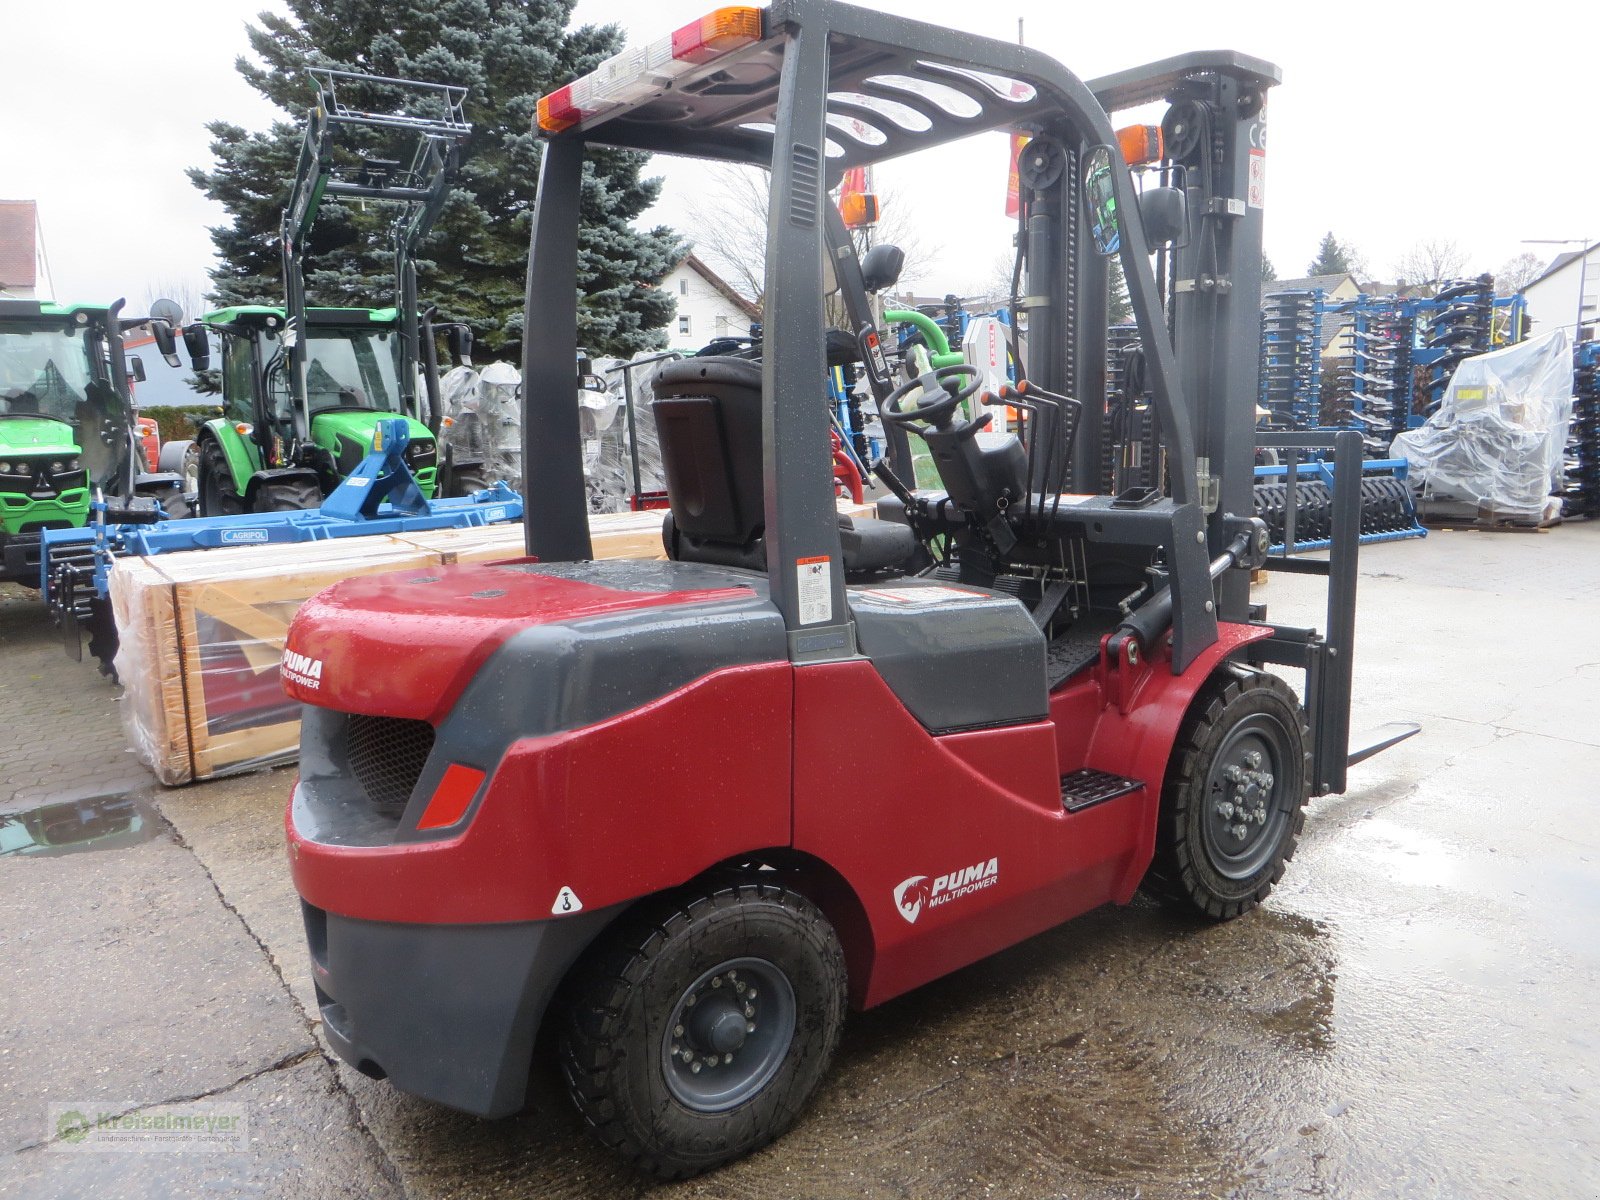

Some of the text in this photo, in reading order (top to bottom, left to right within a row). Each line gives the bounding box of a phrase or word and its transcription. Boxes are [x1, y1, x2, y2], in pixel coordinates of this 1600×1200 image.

[232, 531, 266, 539] AGRIPOL
[283, 648, 322, 679] PUMA
[929, 875, 998, 908] MULTIPOWER
[931, 857, 998, 897] PUMA
